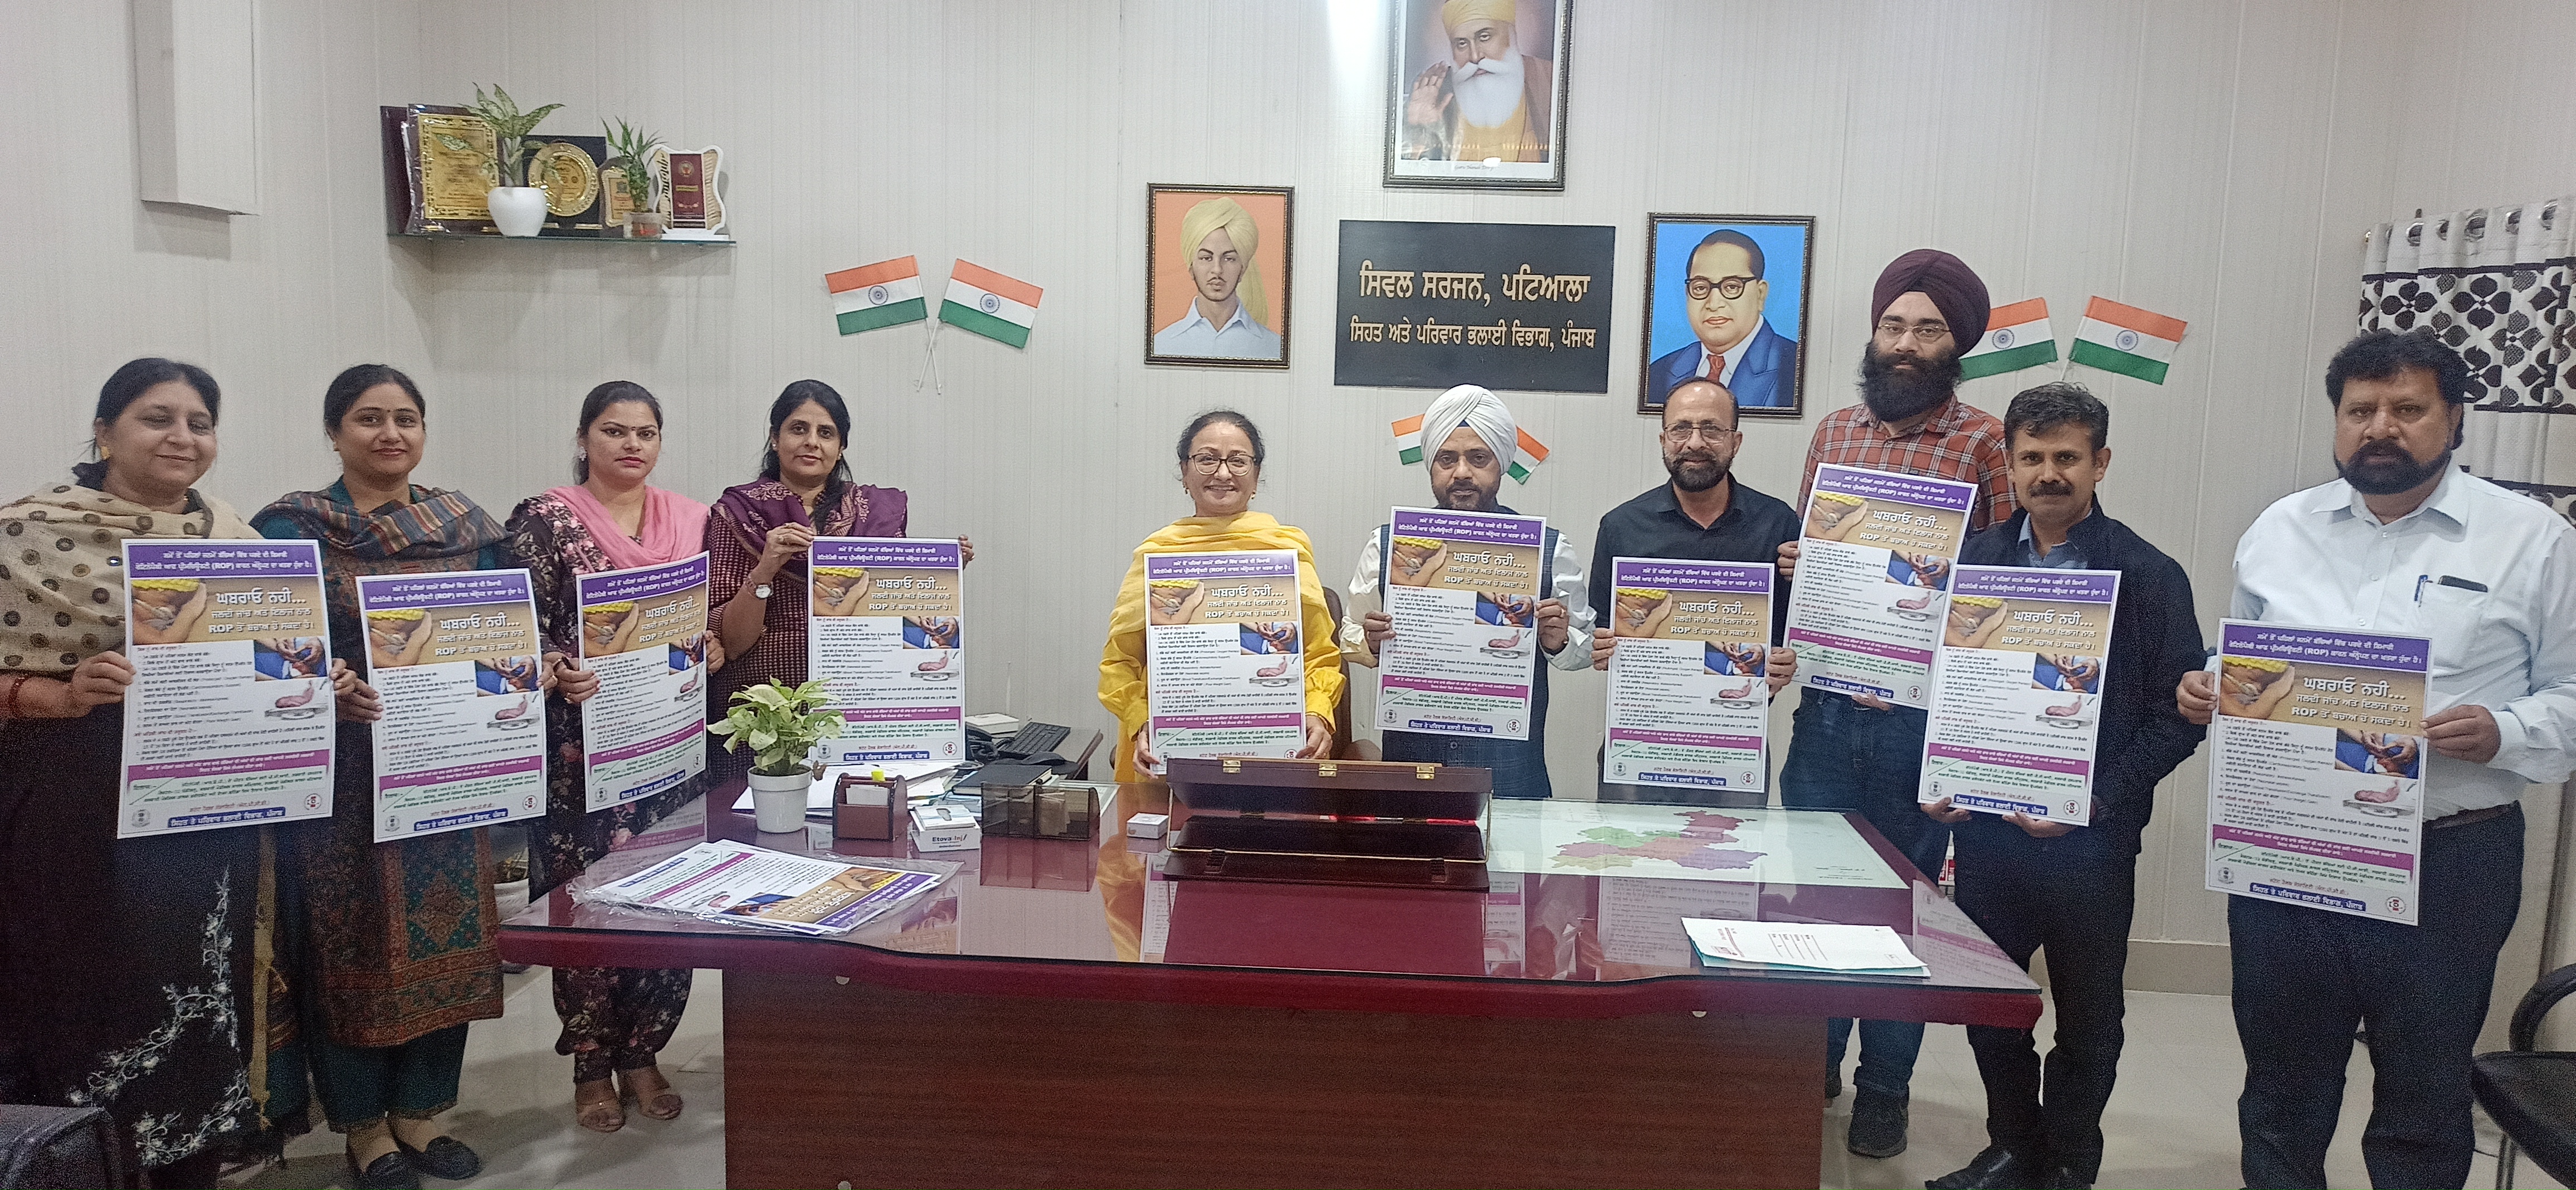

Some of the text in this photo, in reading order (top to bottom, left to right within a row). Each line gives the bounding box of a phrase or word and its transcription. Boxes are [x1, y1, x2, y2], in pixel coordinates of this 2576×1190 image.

[1360, 260, 1591, 306] ਸਿਵਲ ਸਰਜਨ, ਪਟਿਆਲਾ
[1350, 315, 1597, 352] ਸਿਹਤ ਅਤੇ ਪਰਿਵਾਰ ਭਲਾਈ ਵਿਭਾਗ, ਪੰਜਾਬ
[1873, 510, 1913, 524] ਘਬਰਾਓ
[1859, 532, 1880, 540] ROP
[1453, 550, 1491, 563] ਘਬਰਾਓ
[876, 576, 914, 588] ਘਬਰਾਓ
[215, 587, 264, 604] ਘਬਰਾਓ
[1211, 584, 1248, 597] ਘਬਰਾਓ
[1679, 599, 1719, 612] ਘਬਰਾਓ
[439, 613, 481, 630] ਘਬਰਾਓ
[2014, 609, 2056, 623] ਘਬਰਾਓ
[209, 624, 233, 633] ROP
[435, 647, 456, 655] ROP
[2304, 647, 2329, 657] (ROP)
[2304, 676, 2357, 692] ਘਬਰਾਓ
[2291, 706, 2318, 716] ROP
